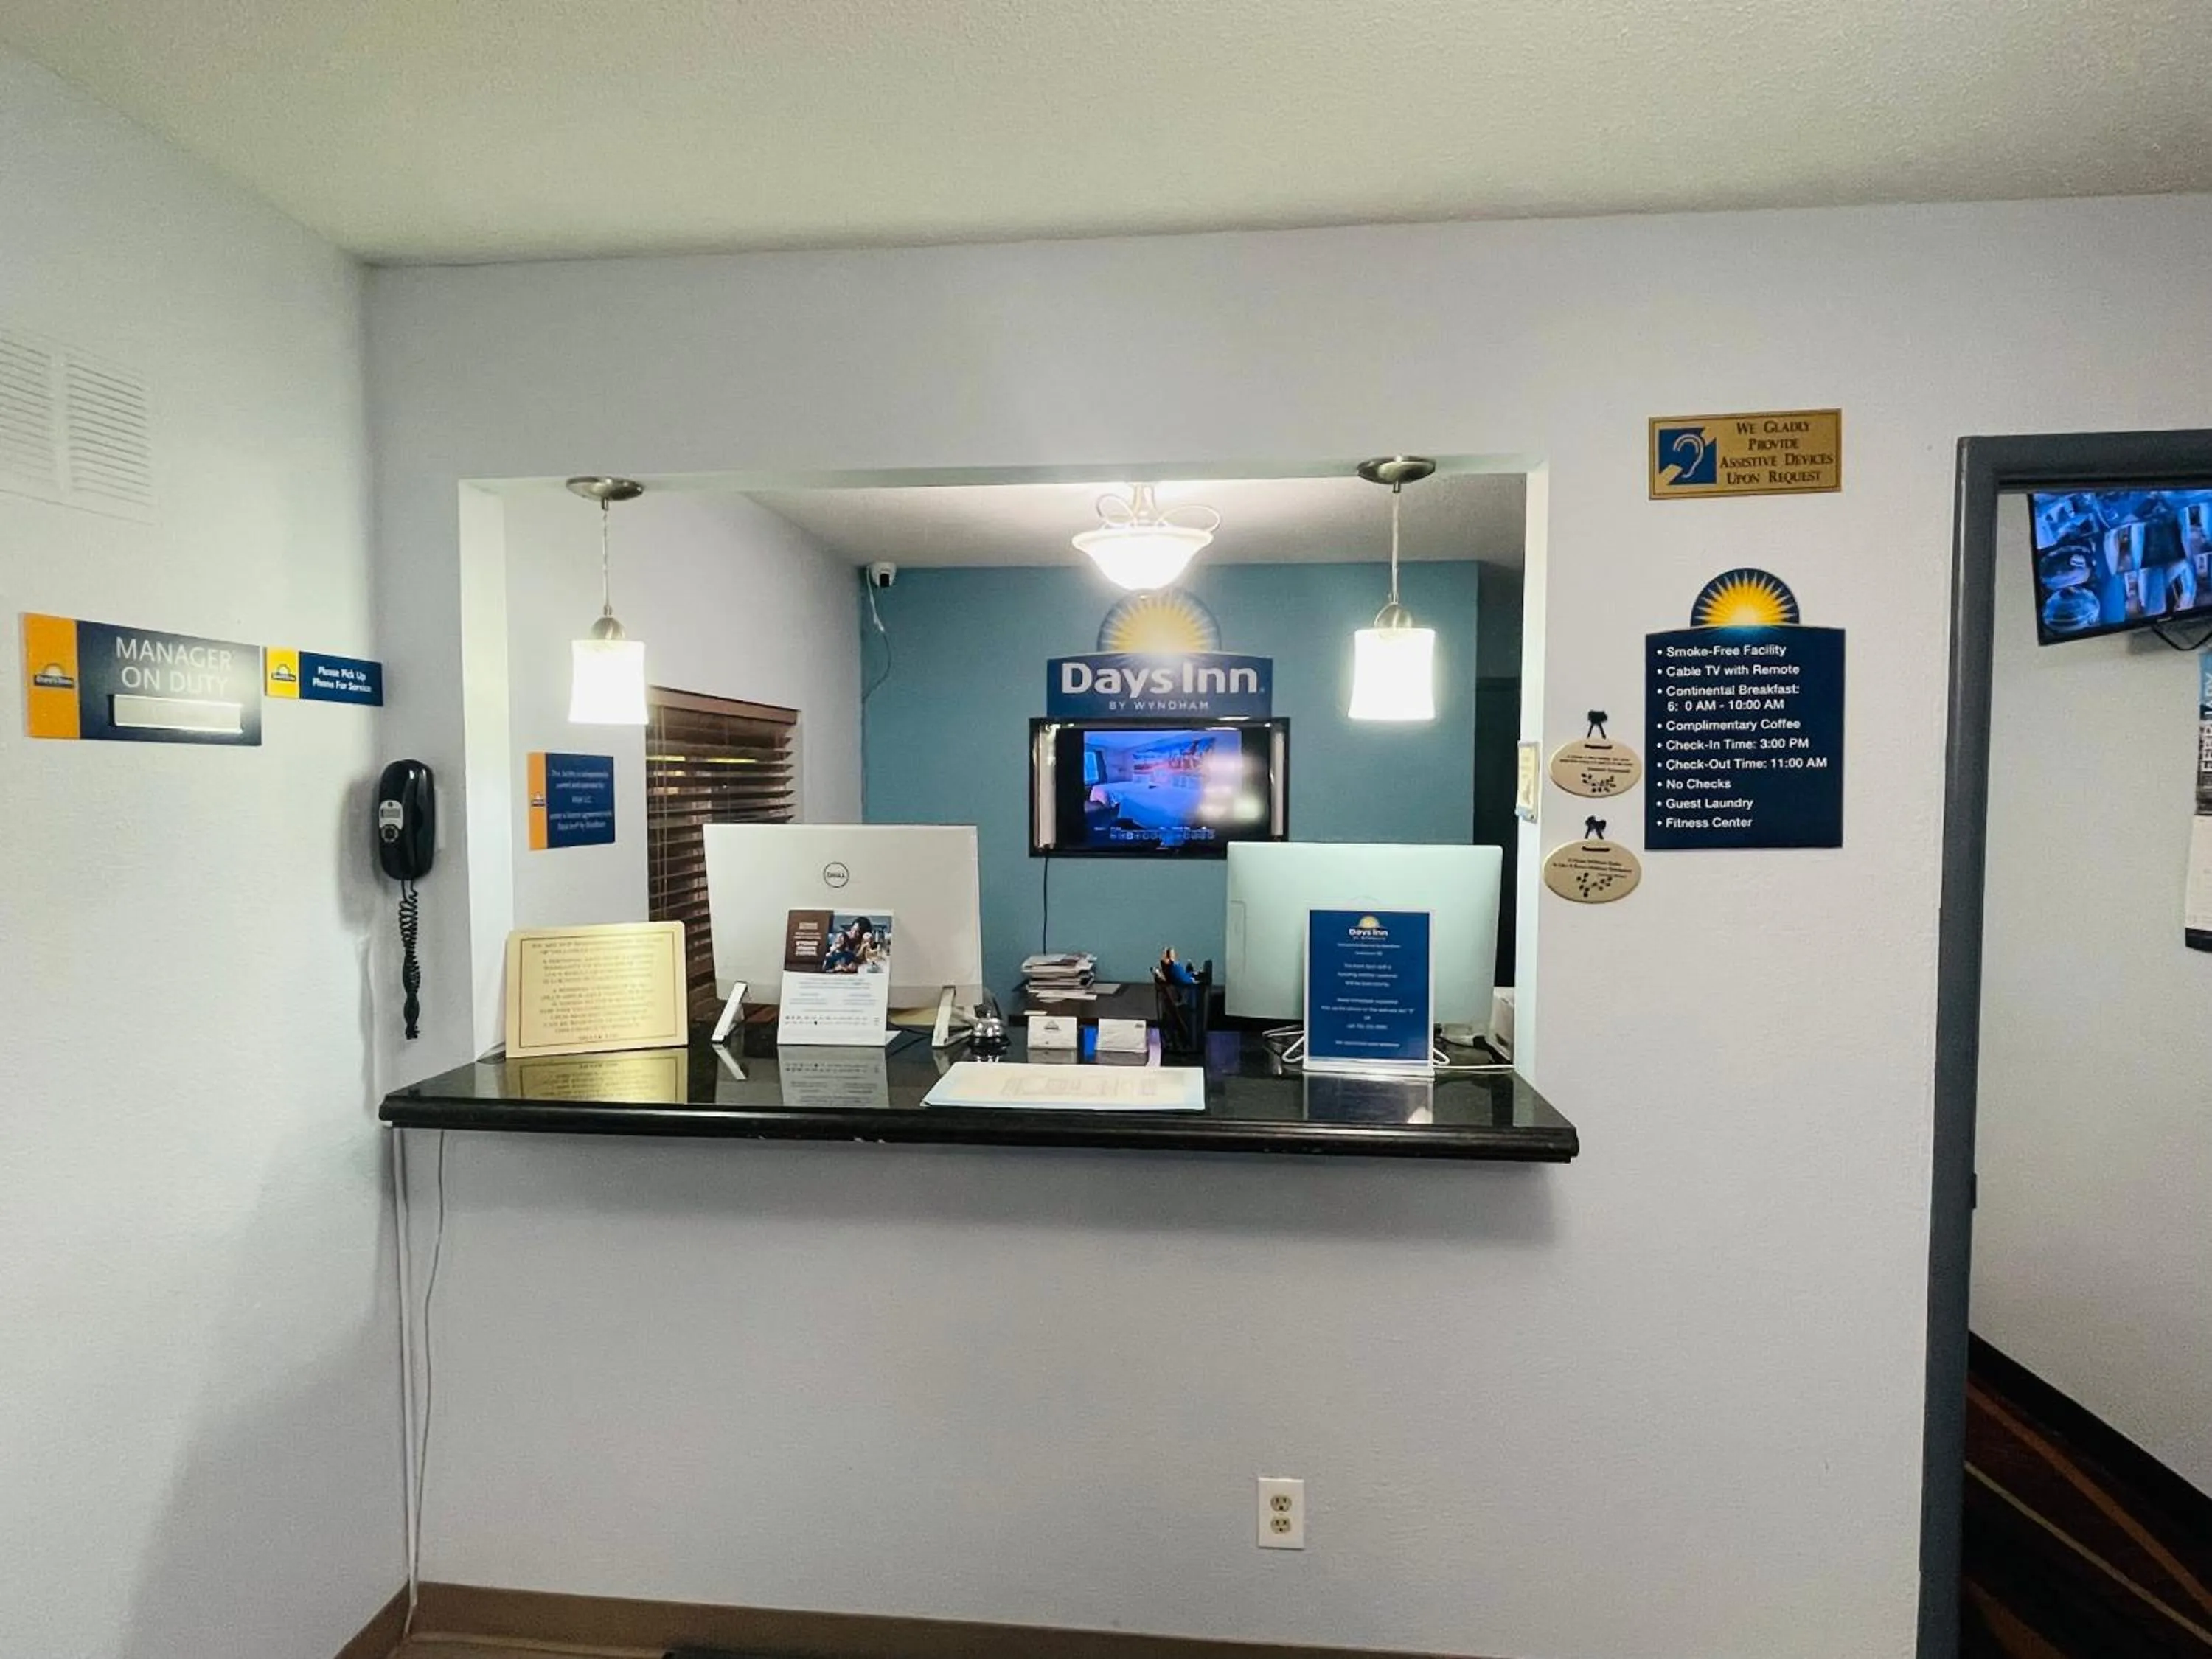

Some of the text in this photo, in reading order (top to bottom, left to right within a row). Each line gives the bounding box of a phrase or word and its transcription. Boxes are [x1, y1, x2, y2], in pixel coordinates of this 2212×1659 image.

[1737, 420, 1809, 434] WE GLADLY
[1749, 438, 1799, 450] PROVIDE
[1719, 453, 1833, 468] ASSISTIVE DEVICES
[1727, 471, 1821, 484] UPON REQUEST
[116, 636, 232, 671] MANAGER
[1666, 644, 1786, 657] Smoke-Free Facility
[318, 666, 340, 678] Please
[341, 669, 355, 678] Pick
[1666, 664, 1800, 677] Cable TV with Remote
[122, 666, 229, 695] ON DUTY
[336, 680, 348, 690] For
[348, 682, 372, 692] Service
[1061, 662, 1258, 698] Days Inn
[1666, 684, 1799, 696] Continental Breakfast:
[1108, 700, 1209, 711] BY WYNDHAM
[1696, 701, 1716, 711] AM
[1728, 700, 1761, 710] 10:00
[1764, 700, 1784, 709] AM
[1666, 719, 1801, 731] Complimentary Coffee
[1666, 739, 1809, 751] Check-In Time: 3:00 PM
[1666, 758, 1827, 770] Check-Out Time: 11:00 AM
[1666, 779, 1731, 790] No Checks
[1666, 798, 1753, 810] Guest Laundry
[1666, 818, 1753, 828] Fitness Center
